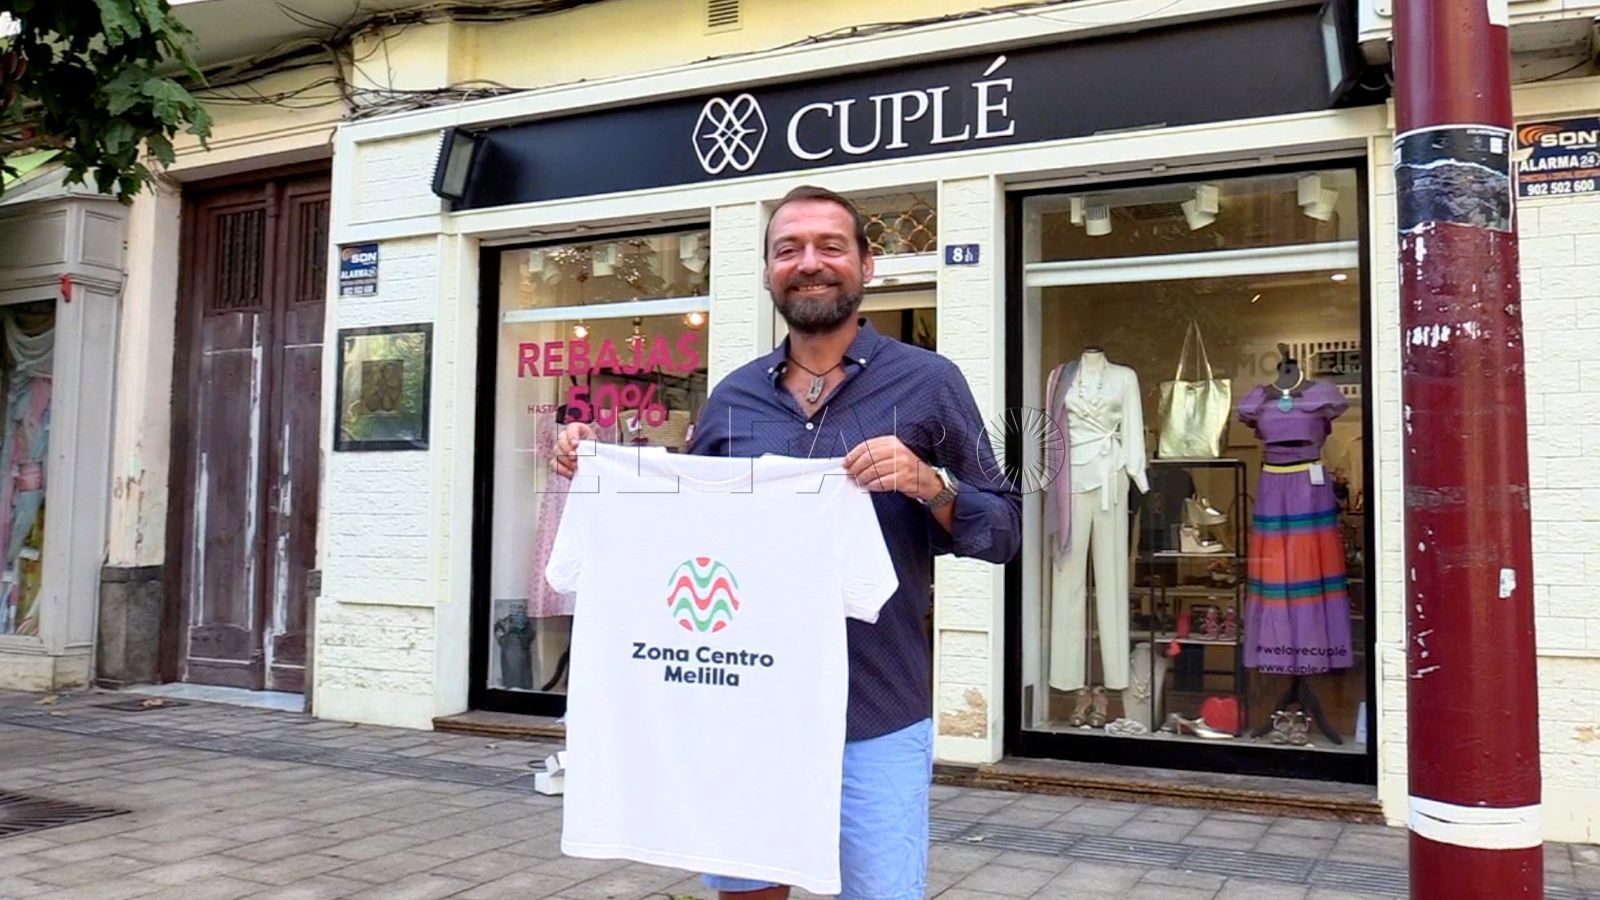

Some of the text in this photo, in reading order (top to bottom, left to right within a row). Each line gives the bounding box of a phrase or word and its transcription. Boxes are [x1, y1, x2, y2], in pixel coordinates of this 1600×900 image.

[786, 55, 1016, 161] CUPLÉ
[1540, 130, 1600, 148] SDN
[1519, 155, 1580, 172] ALARMA
[1527, 179, 1595, 196] 902 502 600
[351, 252, 377, 264] SDN
[517, 332, 701, 378] REBAJAS
[566, 382, 669, 428] 50%
[632, 642, 774, 667] Zona Centro
[1255, 644, 1348, 657] #welovecuplé
[664, 665, 740, 687] Melilla
[1257, 663, 1330, 674] www.cuple.c
